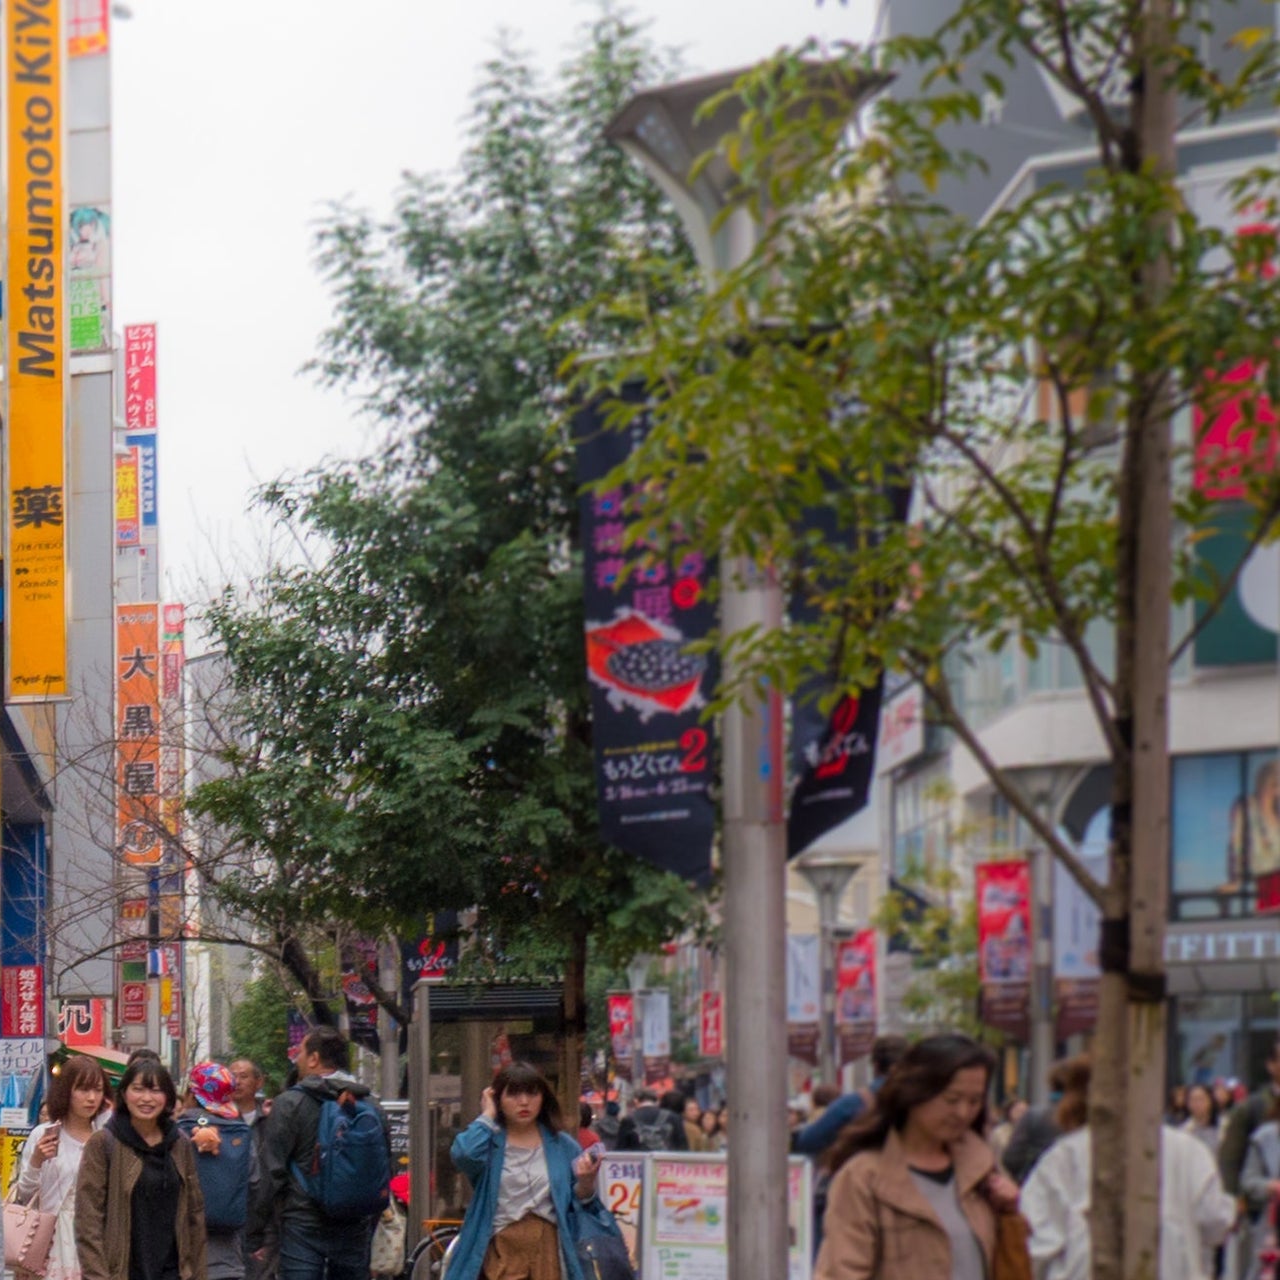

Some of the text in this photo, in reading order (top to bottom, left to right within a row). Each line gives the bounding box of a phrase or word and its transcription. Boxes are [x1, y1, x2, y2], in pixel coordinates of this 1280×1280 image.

[13, 0, 56, 378] Matsumoto KiY
[11, 485, 63, 529] 薬
[120, 648, 156, 794] 大黒屋
[18, 968, 38, 1034] 処方せん受付
[2, 1042, 43, 1055] ネイル
[2, 1057, 44, 1070] サロン
